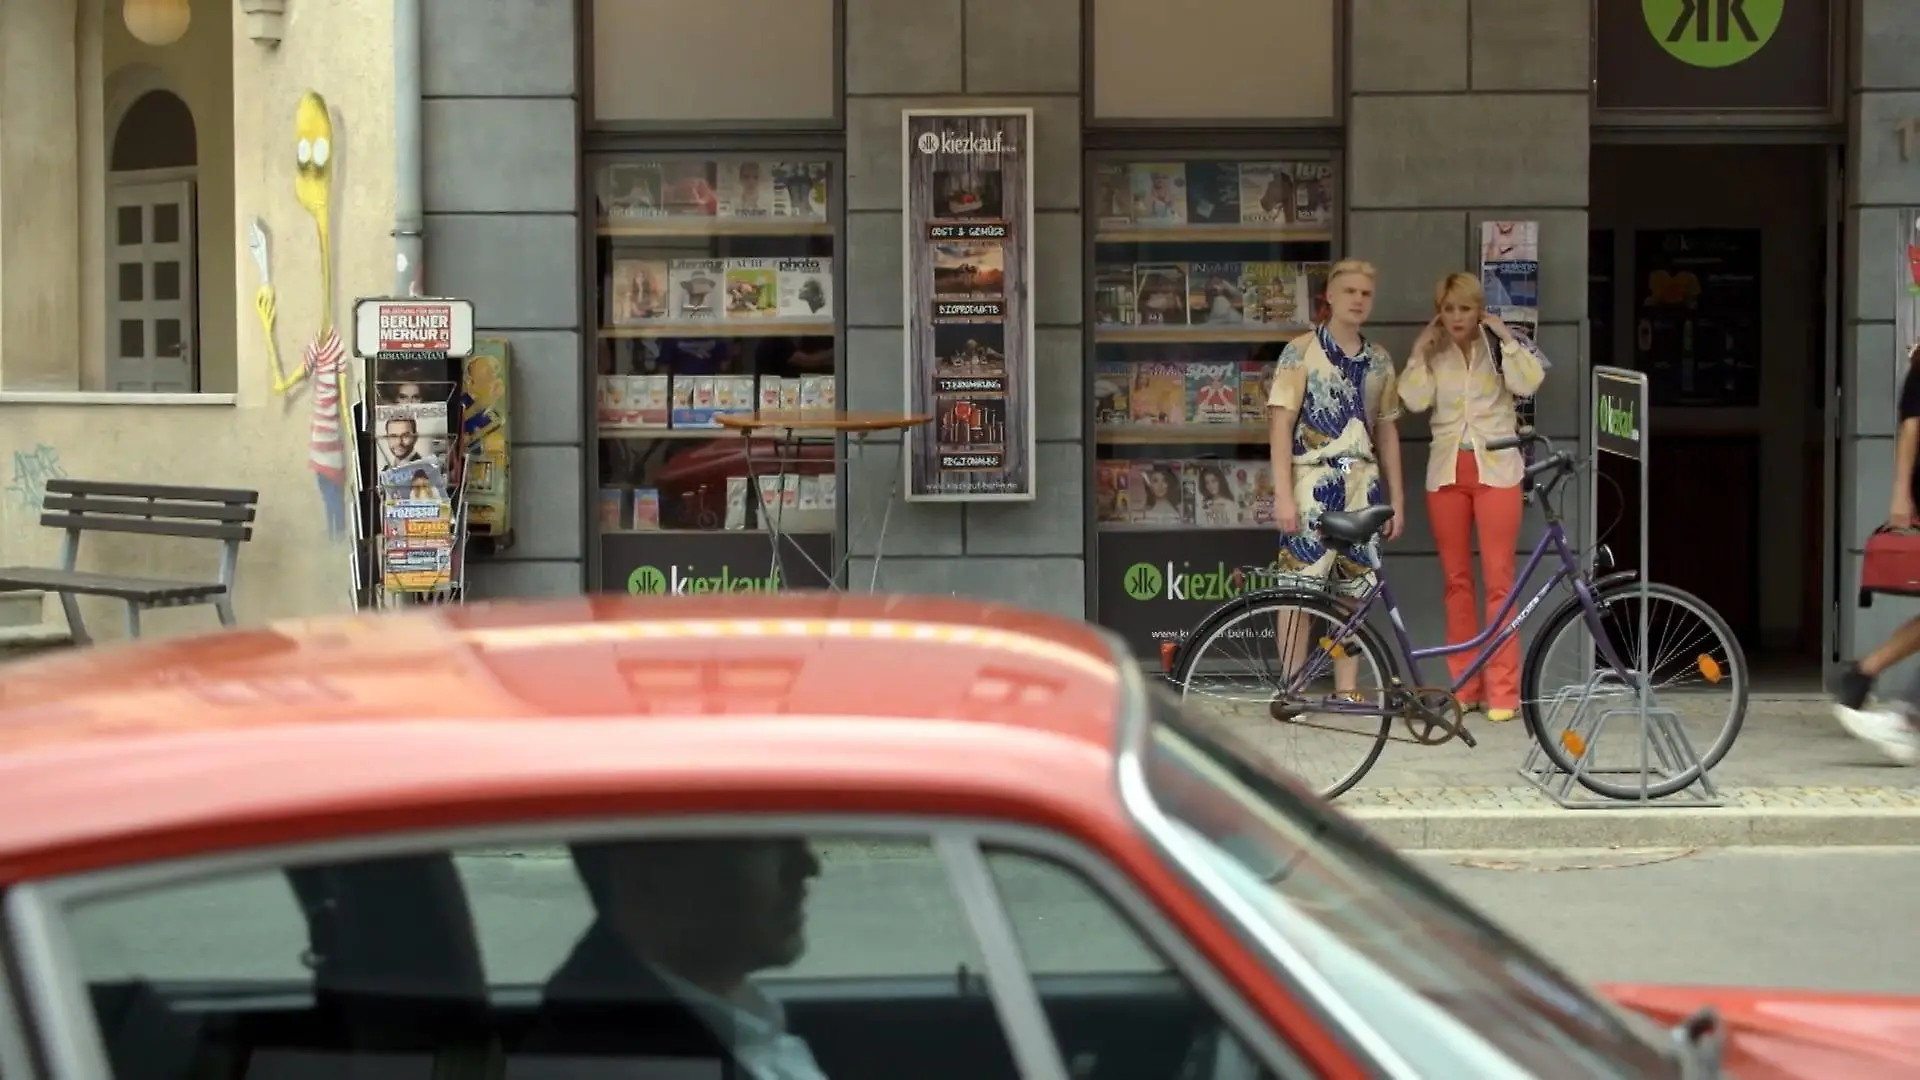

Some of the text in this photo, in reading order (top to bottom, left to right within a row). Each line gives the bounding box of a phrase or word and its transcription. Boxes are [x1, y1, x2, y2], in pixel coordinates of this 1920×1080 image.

[942, 131, 1003, 154] kiezkauf
[779, 257, 820, 272] photo
[381, 315, 449, 328] BERLINER
[381, 328, 438, 340] MERKUR
[1186, 361, 1234, 380] sport
[671, 564, 780, 597] kiezkauf
[1167, 560, 1278, 600] kiezkuf
